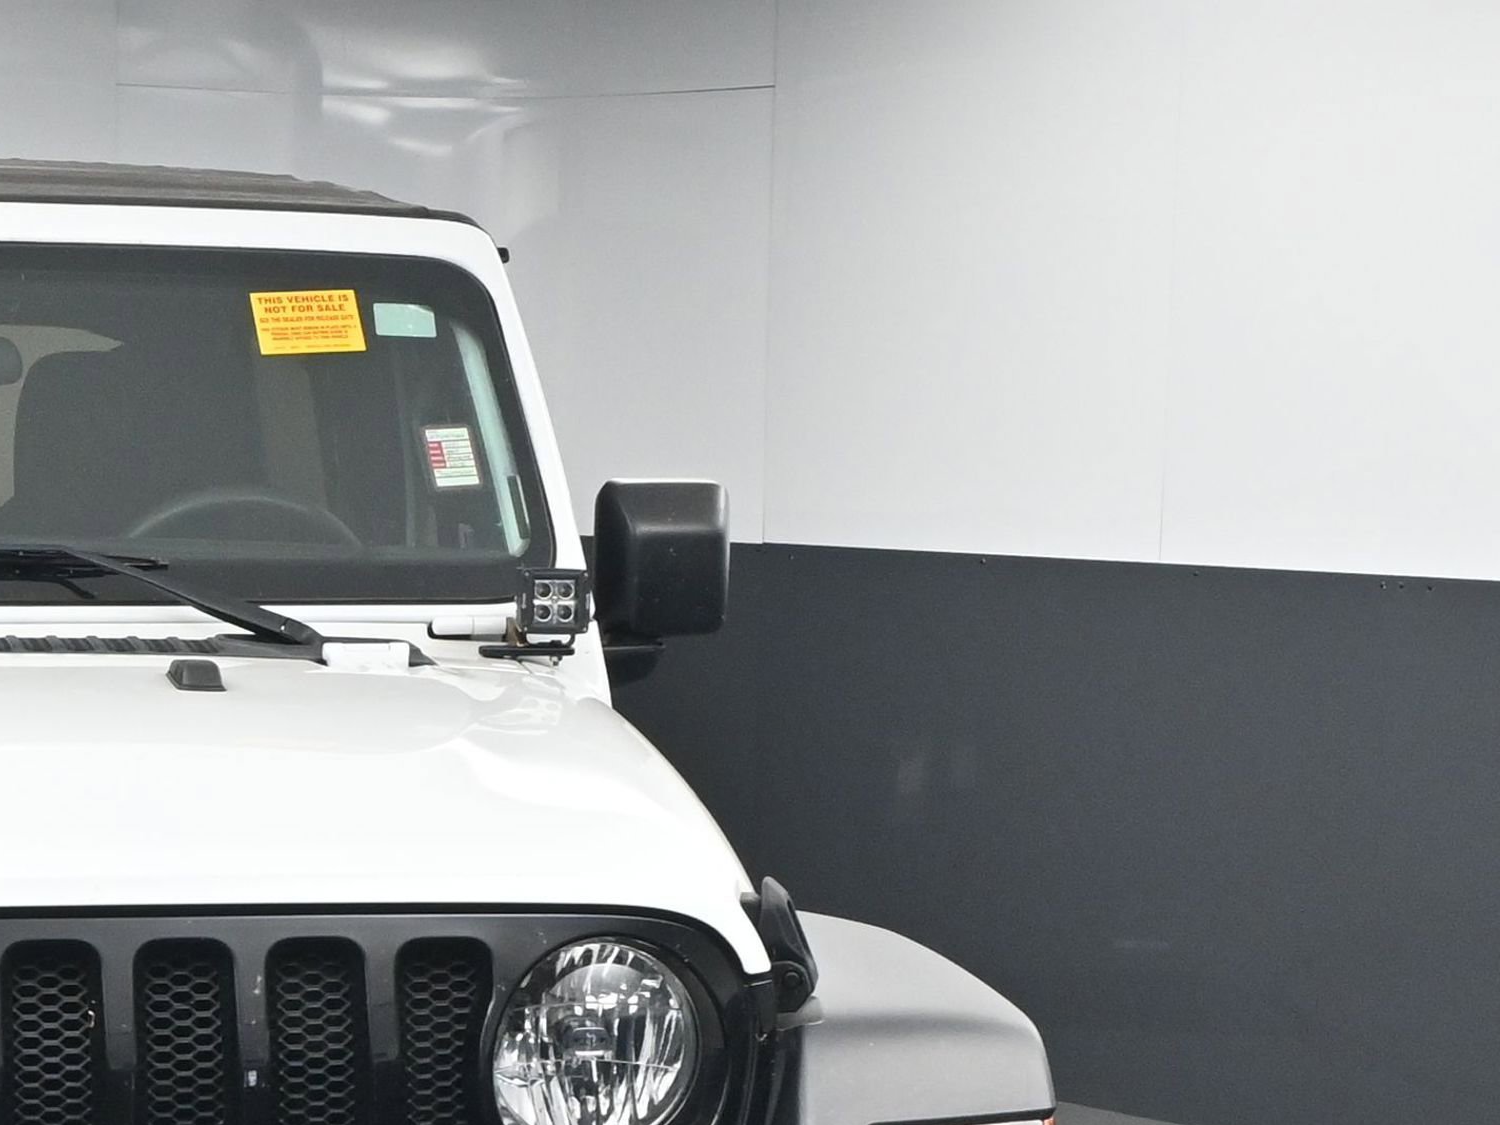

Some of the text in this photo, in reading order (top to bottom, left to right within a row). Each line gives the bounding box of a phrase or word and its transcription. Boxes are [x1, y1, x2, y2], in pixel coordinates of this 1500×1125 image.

[257, 294, 349, 305] THIS VEHICLE IS
[264, 303, 346, 314] NOT FOR SALE
